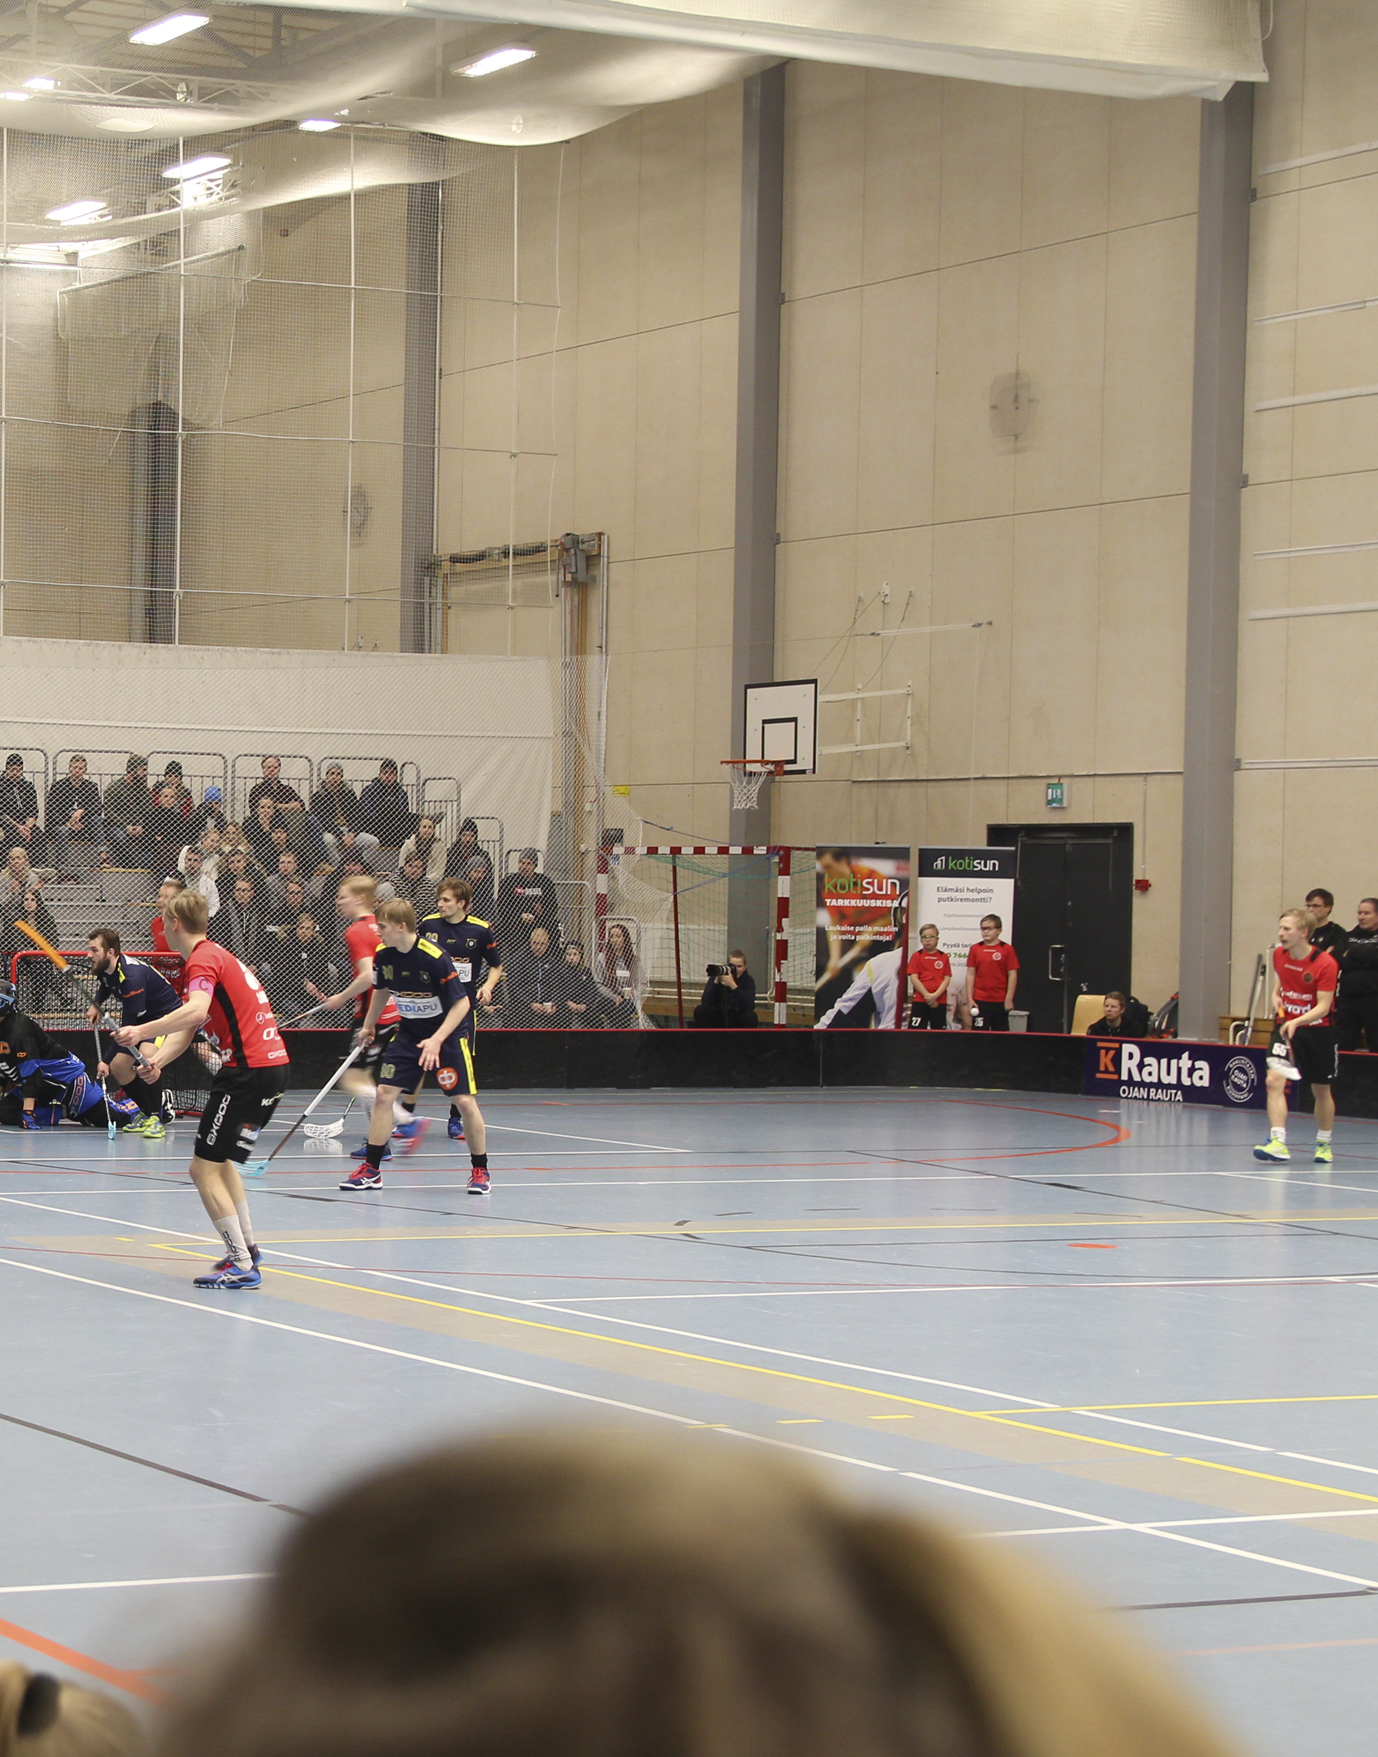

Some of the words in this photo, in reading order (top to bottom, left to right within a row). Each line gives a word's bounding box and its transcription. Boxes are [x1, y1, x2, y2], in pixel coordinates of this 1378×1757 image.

[948, 856, 999, 871] kotisun
[824, 872, 900, 895] kotisun
[966, 886, 994, 895] helpoin
[824, 898, 900, 907] TARKKUUSKISA
[937, 896, 993, 904] putkiremontti?
[855, 925, 873, 933] pallo
[855, 934, 893, 942] palkintoja!
[199, 978, 210, 991] C
[396, 1002, 439, 1013] EDIAPU
[1099, 1049, 1116, 1072] K
[1120, 1043, 1211, 1088] Rauta
[1119, 1085, 1148, 1100] OJAN
[1149, 1088, 1183, 1102] RAUTA
